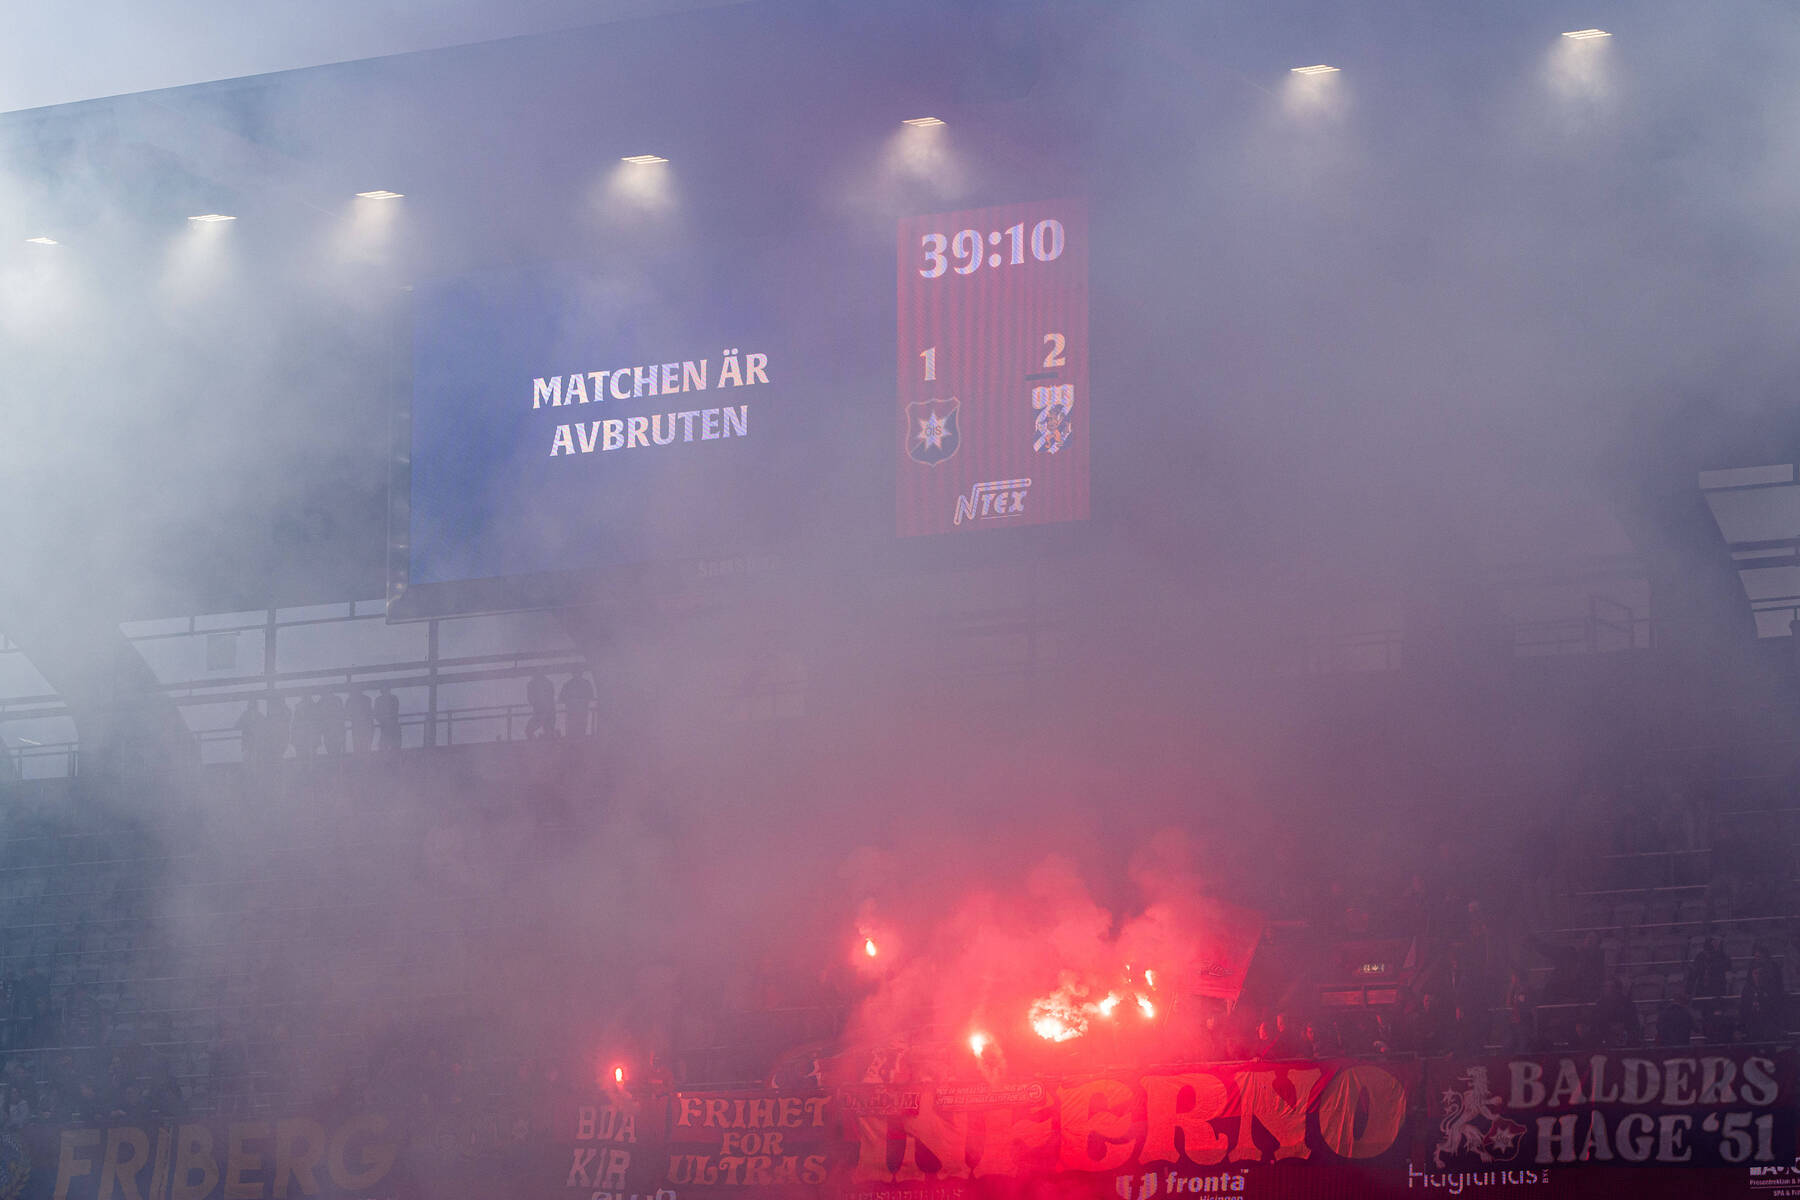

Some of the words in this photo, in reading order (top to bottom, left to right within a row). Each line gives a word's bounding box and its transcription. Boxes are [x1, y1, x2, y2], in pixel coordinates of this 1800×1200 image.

[919, 219, 1065, 279] 39:10
[919, 346, 937, 381] 1
[1043, 333, 1066, 368] 2
[532, 359, 708, 409] MATCHEN
[718, 348, 770, 389] ÄR
[549, 405, 749, 457] AVBRUTEN
[953, 478, 1032, 526] NTEX
[1507, 1055, 1779, 1109] BALDERS
[677, 1095, 832, 1129] FRIHET
[1534, 1109, 1692, 1164] HAGE
[52, 1114, 400, 1200] FRIBERG
[667, 1154, 829, 1186] ULTRAS
